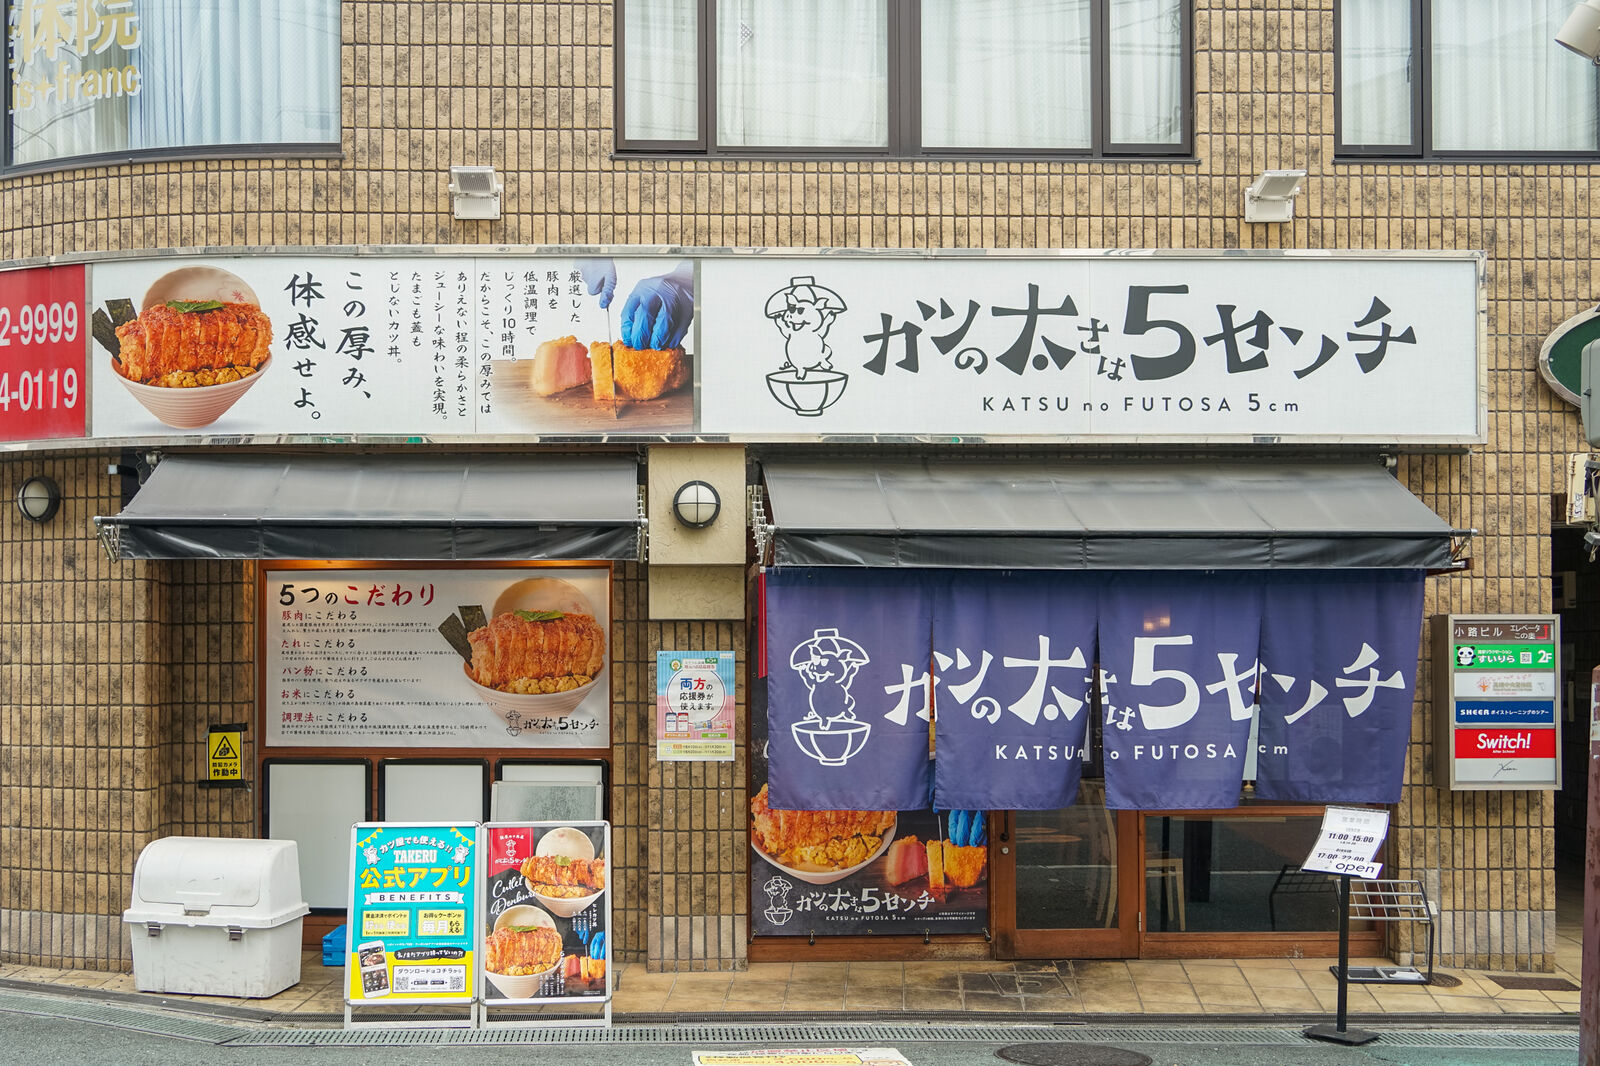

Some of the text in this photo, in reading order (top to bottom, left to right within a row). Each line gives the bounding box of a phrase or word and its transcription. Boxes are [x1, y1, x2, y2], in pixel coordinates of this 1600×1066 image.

[546, 271, 560, 310] 豚肉を
[568, 270, 583, 324] 厳選した
[410, 271, 424, 347] たまごも蓋も
[523, 270, 539, 336] 低温調理で
[387, 271, 403, 364] とじないカツ丼。
[501, 271, 517, 363] じっくり10時間。
[335, 271, 376, 400] この厚み、
[862, 283, 1418, 382] カツの太さは5センチ
[282, 271, 327, 420] 体感せよ。
[432, 271, 448, 421] ジューシーな味わいを実現。
[454, 271, 470, 417] ありえない程の柔らかさと
[982, 396, 1071, 412] KATSU
[1082, 400, 1110, 413] no
[1124, 396, 1232, 412] FUTOSA
[279, 583, 435, 607] 5つのこだわり
[281, 610, 358, 621] 豚肉にこだわる
[1454, 626, 1503, 638] 小路ビル
[281, 638, 356, 649] たれにこだわる
[1478, 655, 1516, 664] すいりら
[1537, 649, 1553, 664] 2F
[282, 665, 369, 677] パン粉にこだわる
[680, 677, 713, 691] 両方の
[281, 688, 356, 700] お米にこだわる
[679, 691, 714, 701] 応援券が
[281, 711, 369, 723] 調理法にこだわる
[1476, 732, 1532, 750] Switch!
[995, 744, 1074, 761] KATSU
[1134, 743, 1238, 760] FUTOSA
[213, 768, 238, 776] 作動中
[393, 849, 438, 864] TAKERU
[1335, 862, 1376, 874] open
[360, 866, 471, 889] 公式アプリ
[492, 874, 525, 899] Cutlet
[379, 893, 452, 902] BENEFITS
[422, 920, 449, 934] 毎月
